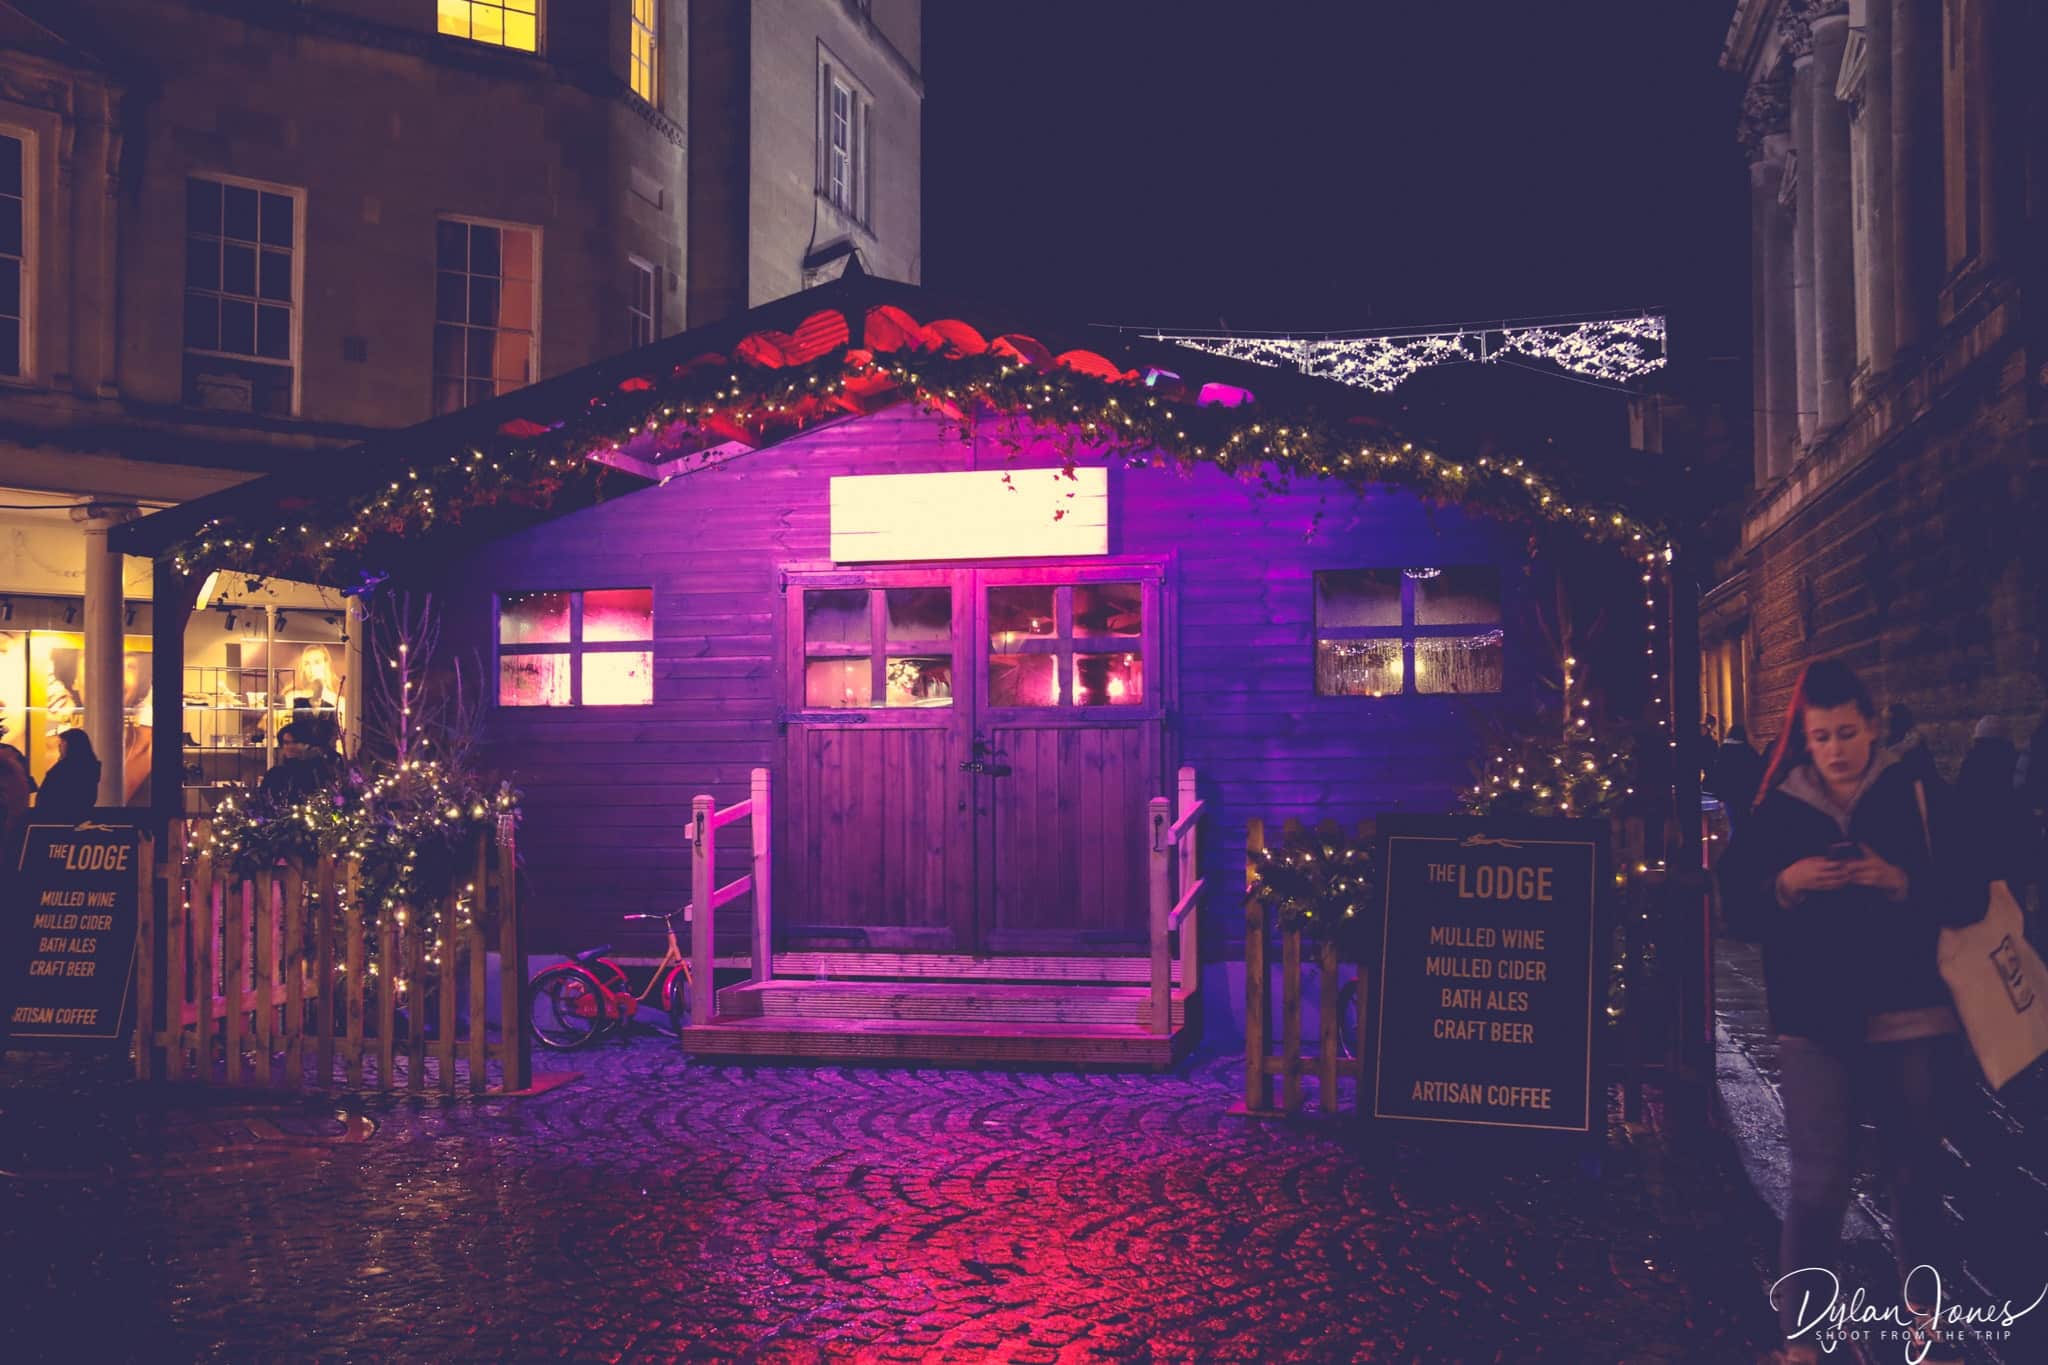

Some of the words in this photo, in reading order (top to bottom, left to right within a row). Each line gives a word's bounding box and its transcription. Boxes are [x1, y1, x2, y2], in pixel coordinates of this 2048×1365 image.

[48, 844, 68, 860] THE
[65, 844, 131, 872] LODGE
[1427, 863, 1457, 883] THE
[1458, 864, 1554, 902] LODGE
[40, 890, 84, 907] MULLED
[87, 891, 117, 908] WINE
[33, 914, 77, 930] MULLED
[79, 914, 113, 931] CIDER
[39, 937, 67, 953] BATH
[67, 938, 97, 954] ALES
[1430, 926, 1496, 948] MULLED
[1502, 929, 1545, 951] WINE
[29, 960, 65, 977] CRAFT
[66, 961, 96, 977] BEER
[1426, 956, 1492, 978] MULLED
[1498, 959, 1547, 981] CIDER
[1441, 988, 1482, 1009] BATH
[1487, 991, 1529, 1012] ALES
[55, 1008, 98, 1025] COFFEE
[1433, 1019, 1488, 1041] CRAFT
[1491, 1022, 1535, 1044] BEER
[1411, 1080, 1483, 1105] ARTISAN
[1487, 1085, 1552, 1109] COFFEE
